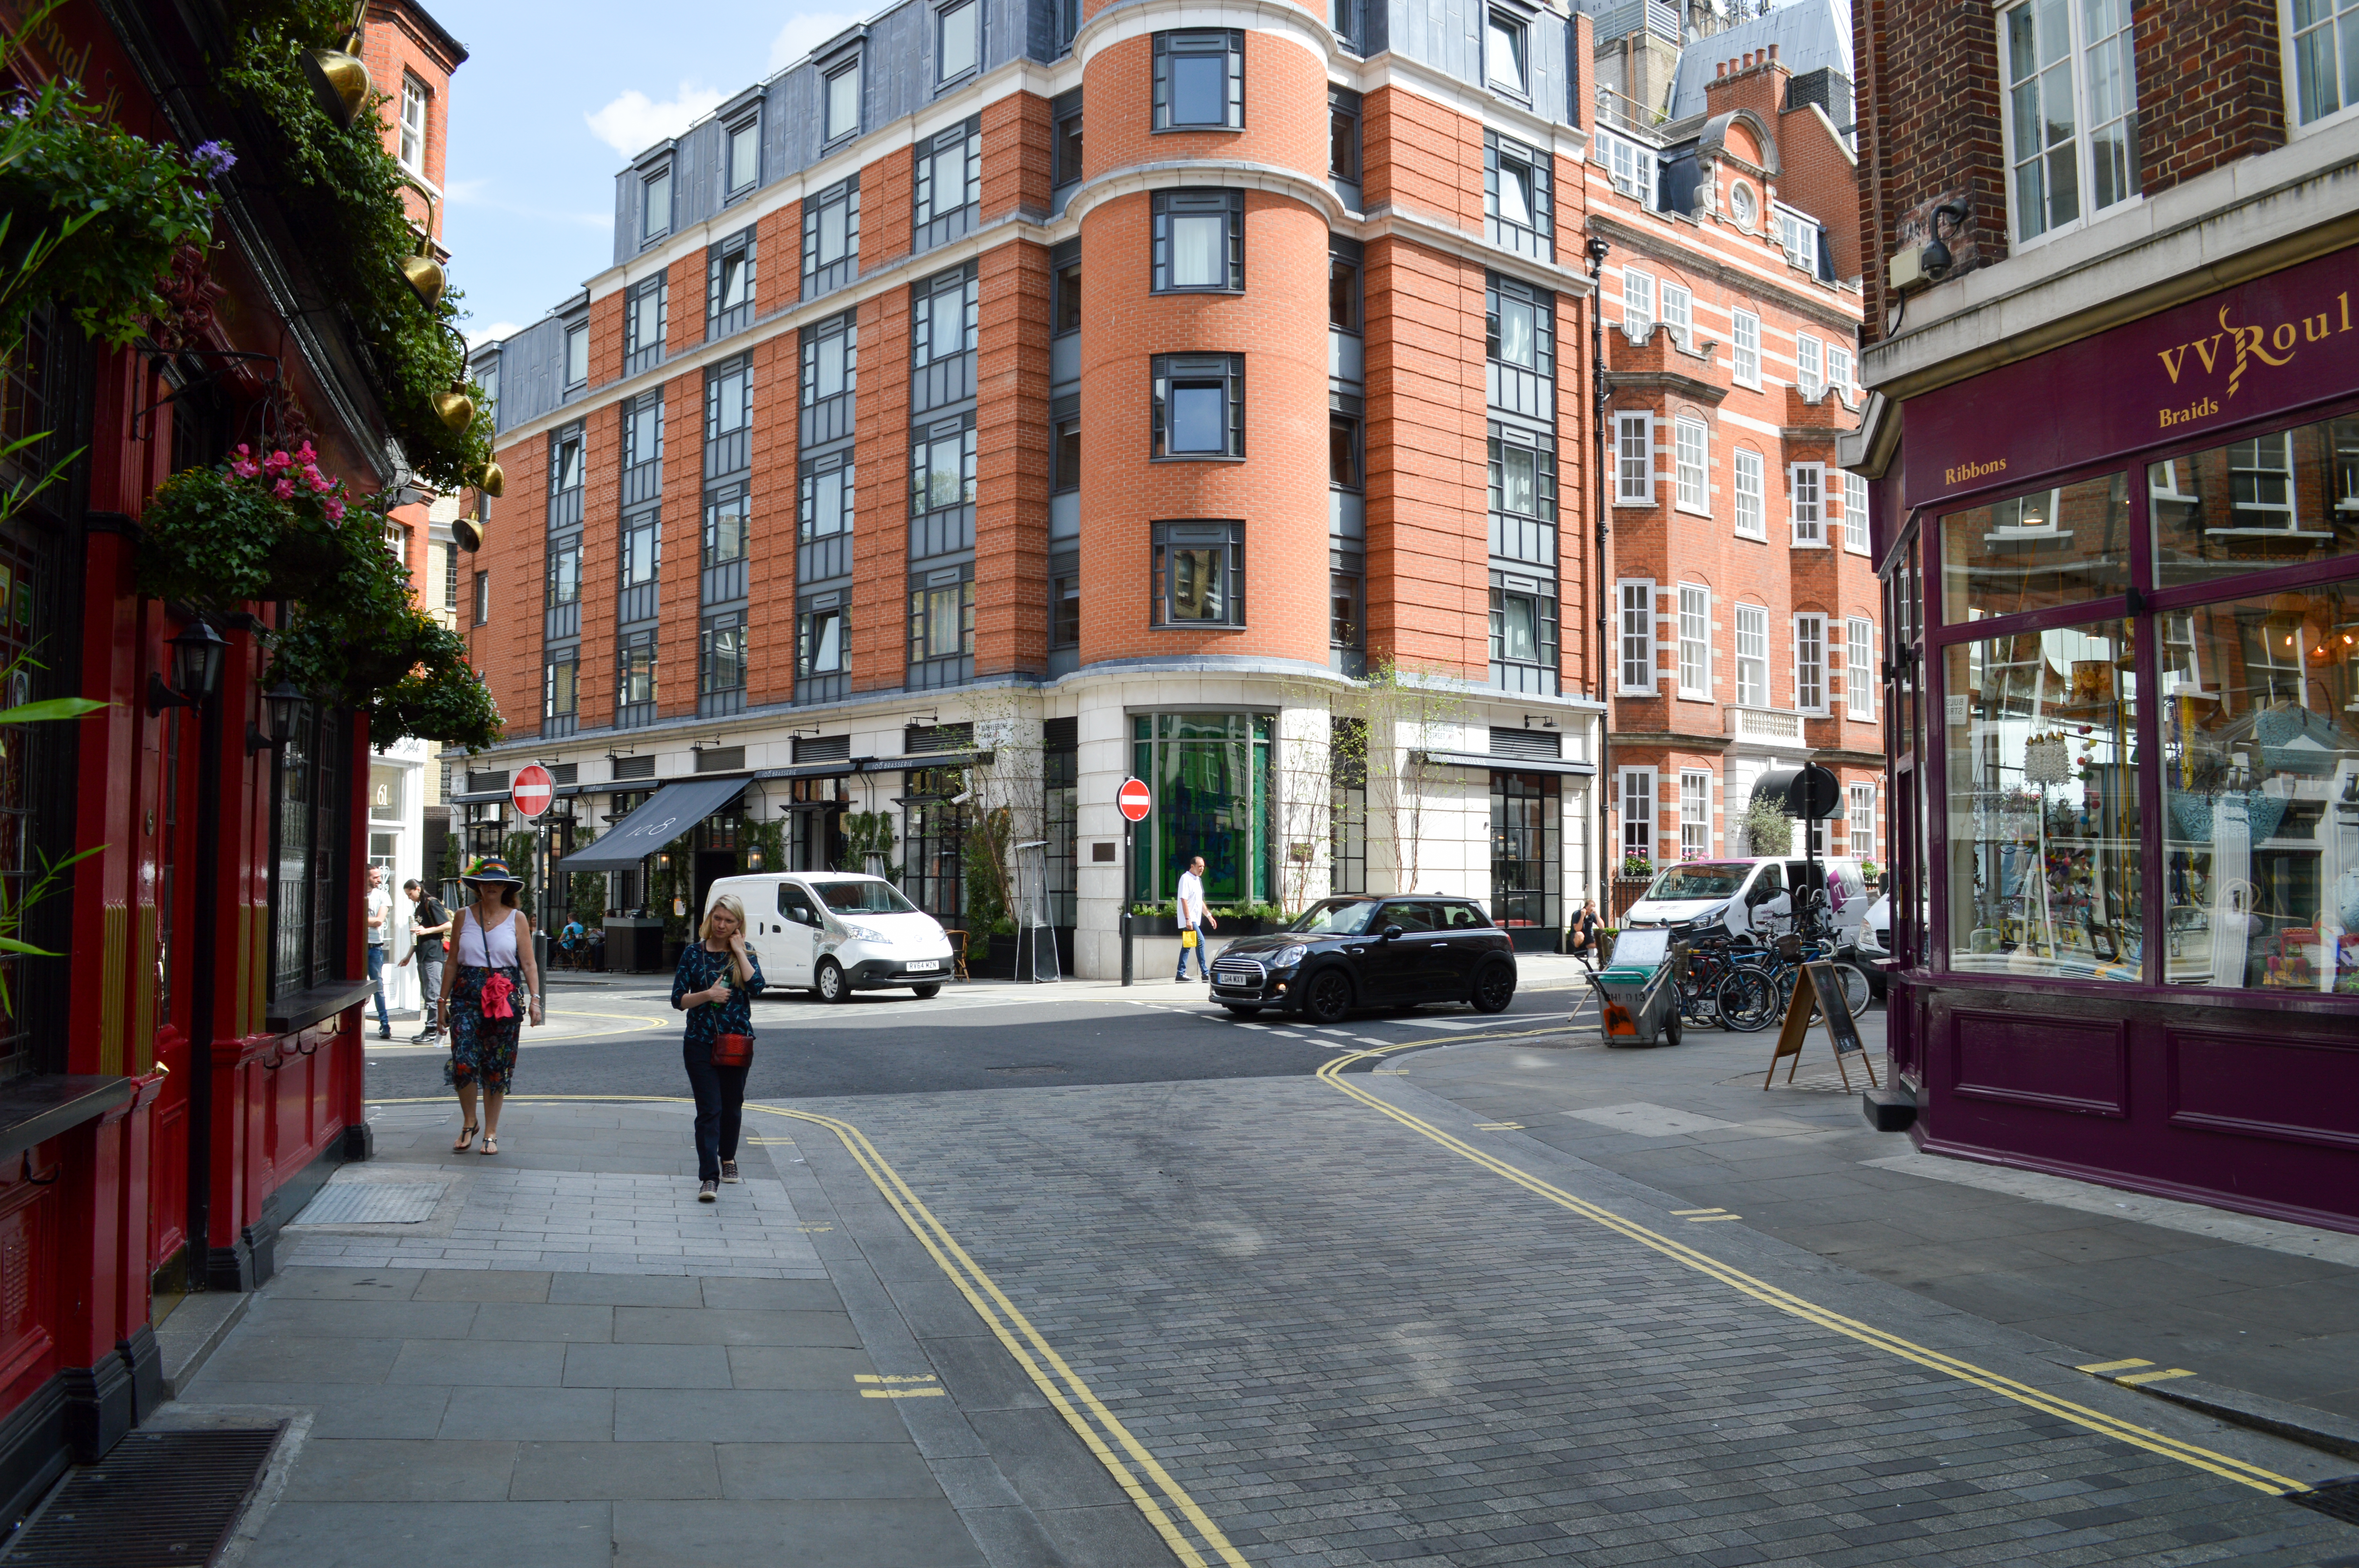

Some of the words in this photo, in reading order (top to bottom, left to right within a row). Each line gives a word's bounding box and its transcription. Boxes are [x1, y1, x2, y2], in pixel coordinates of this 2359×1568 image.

[2159, 397, 2219, 428] Braids
[1945, 458, 2006, 485] Ribbons
[1453, 757, 1487, 765] BRASSERIE
[377, 784, 388, 806] 61
[626, 817, 676, 837] 108
